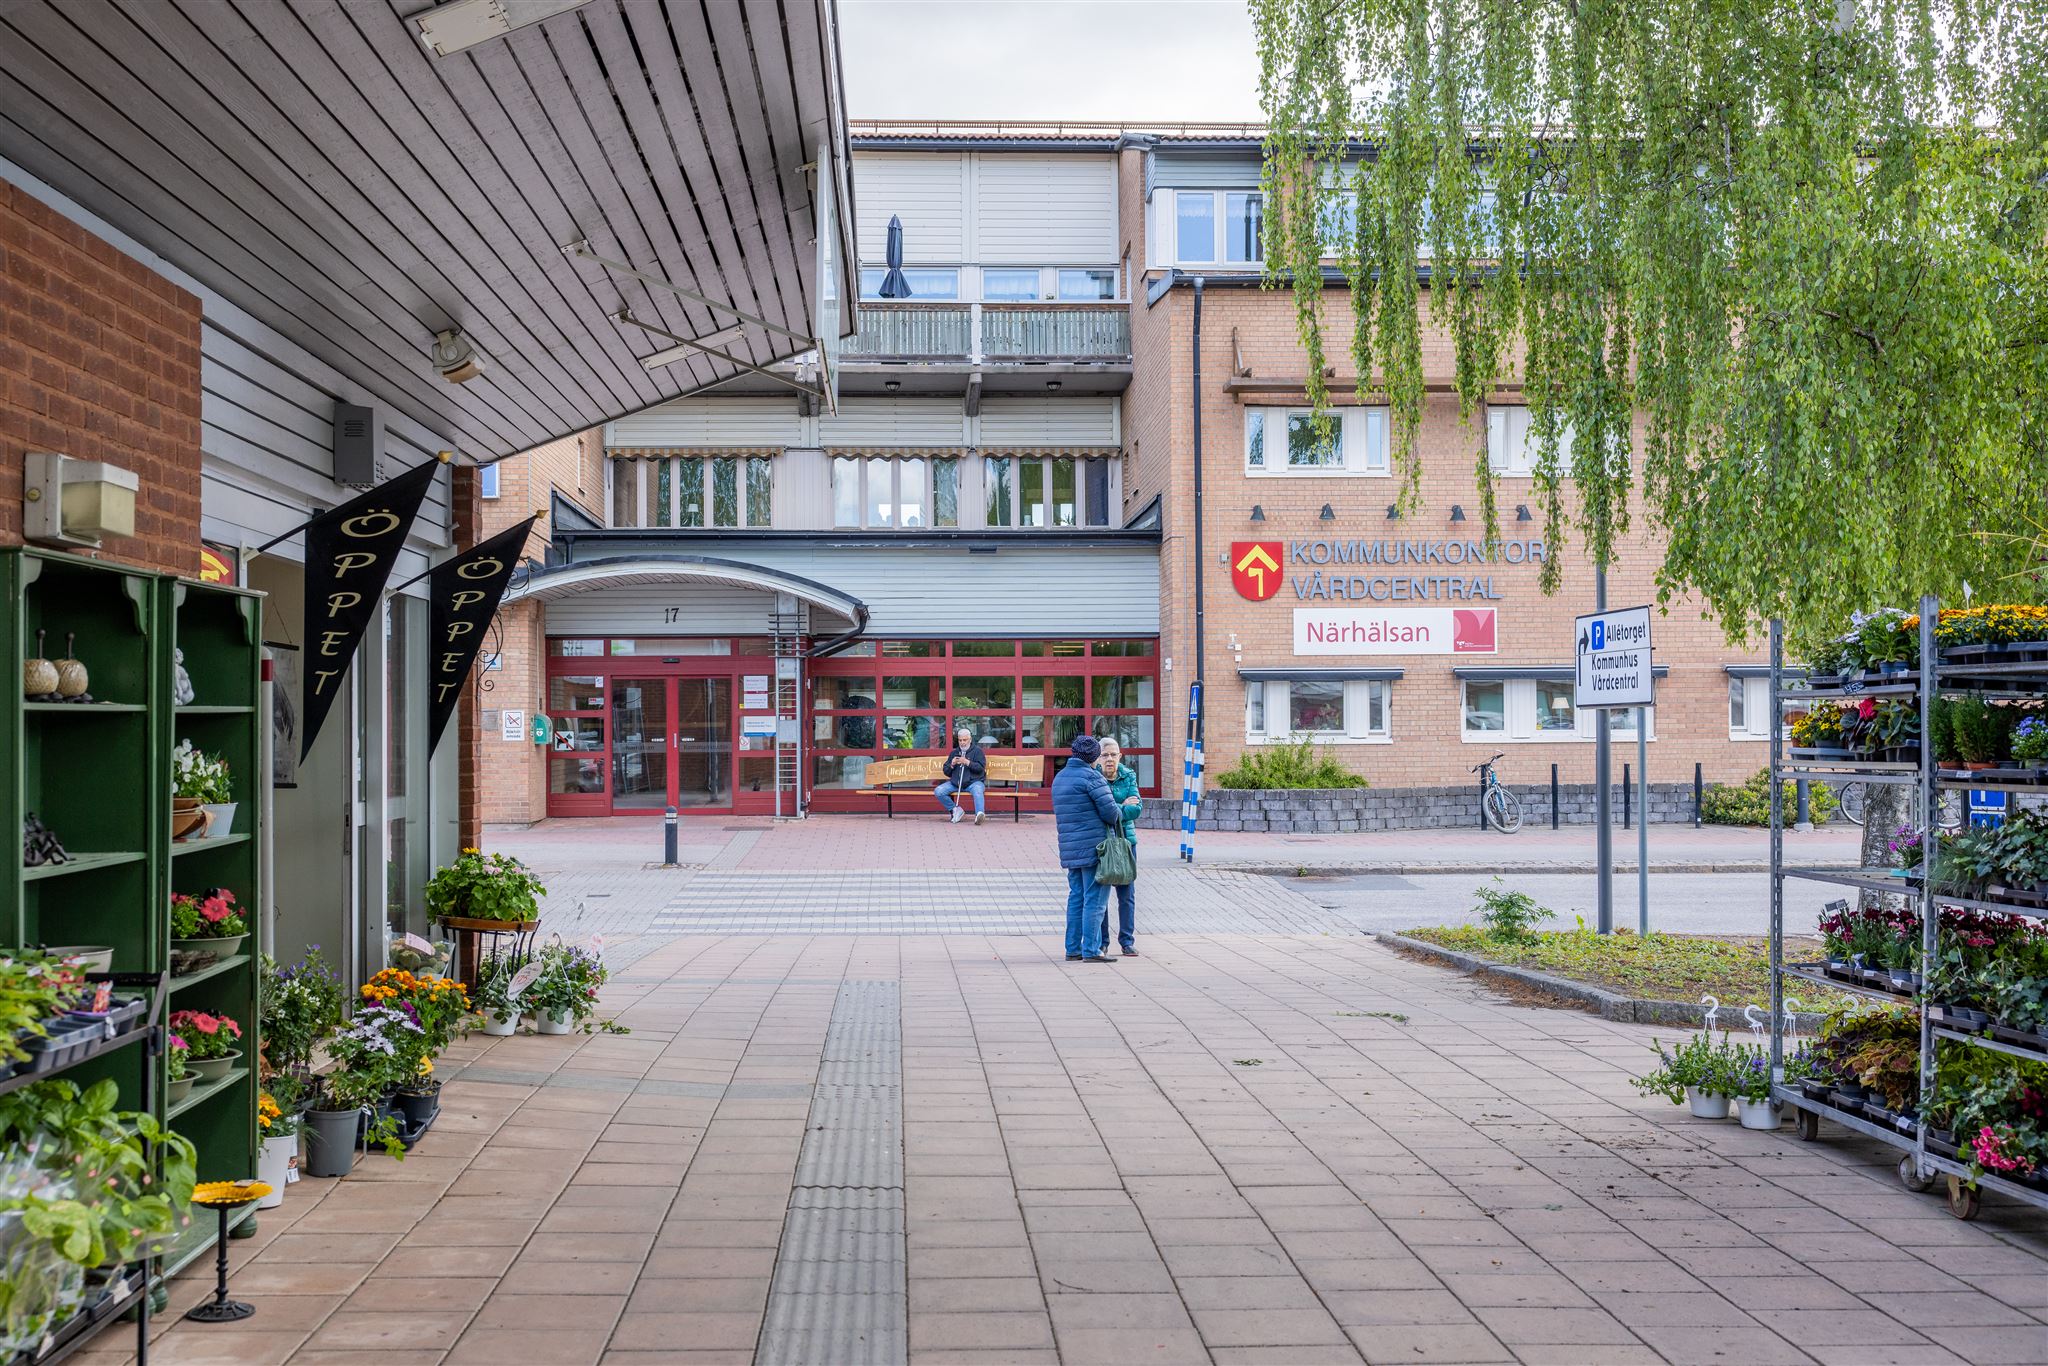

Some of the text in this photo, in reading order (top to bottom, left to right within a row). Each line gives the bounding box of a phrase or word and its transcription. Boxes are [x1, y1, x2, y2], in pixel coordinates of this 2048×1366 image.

[1291, 540, 1548, 565] KOMMUNKONTOR
[1292, 570, 1505, 600] VÅRDCENTRAL
[314, 508, 400, 696] ÖPPET
[664, 607, 680, 624] 17
[437, 556, 504, 703] ÖPPET
[1307, 620, 1430, 643] Närhälsan
[1595, 621, 1646, 646] P Allétorget
[1591, 651, 1639, 671] Kommunhus
[1591, 671, 1639, 691] Vårdcentral
